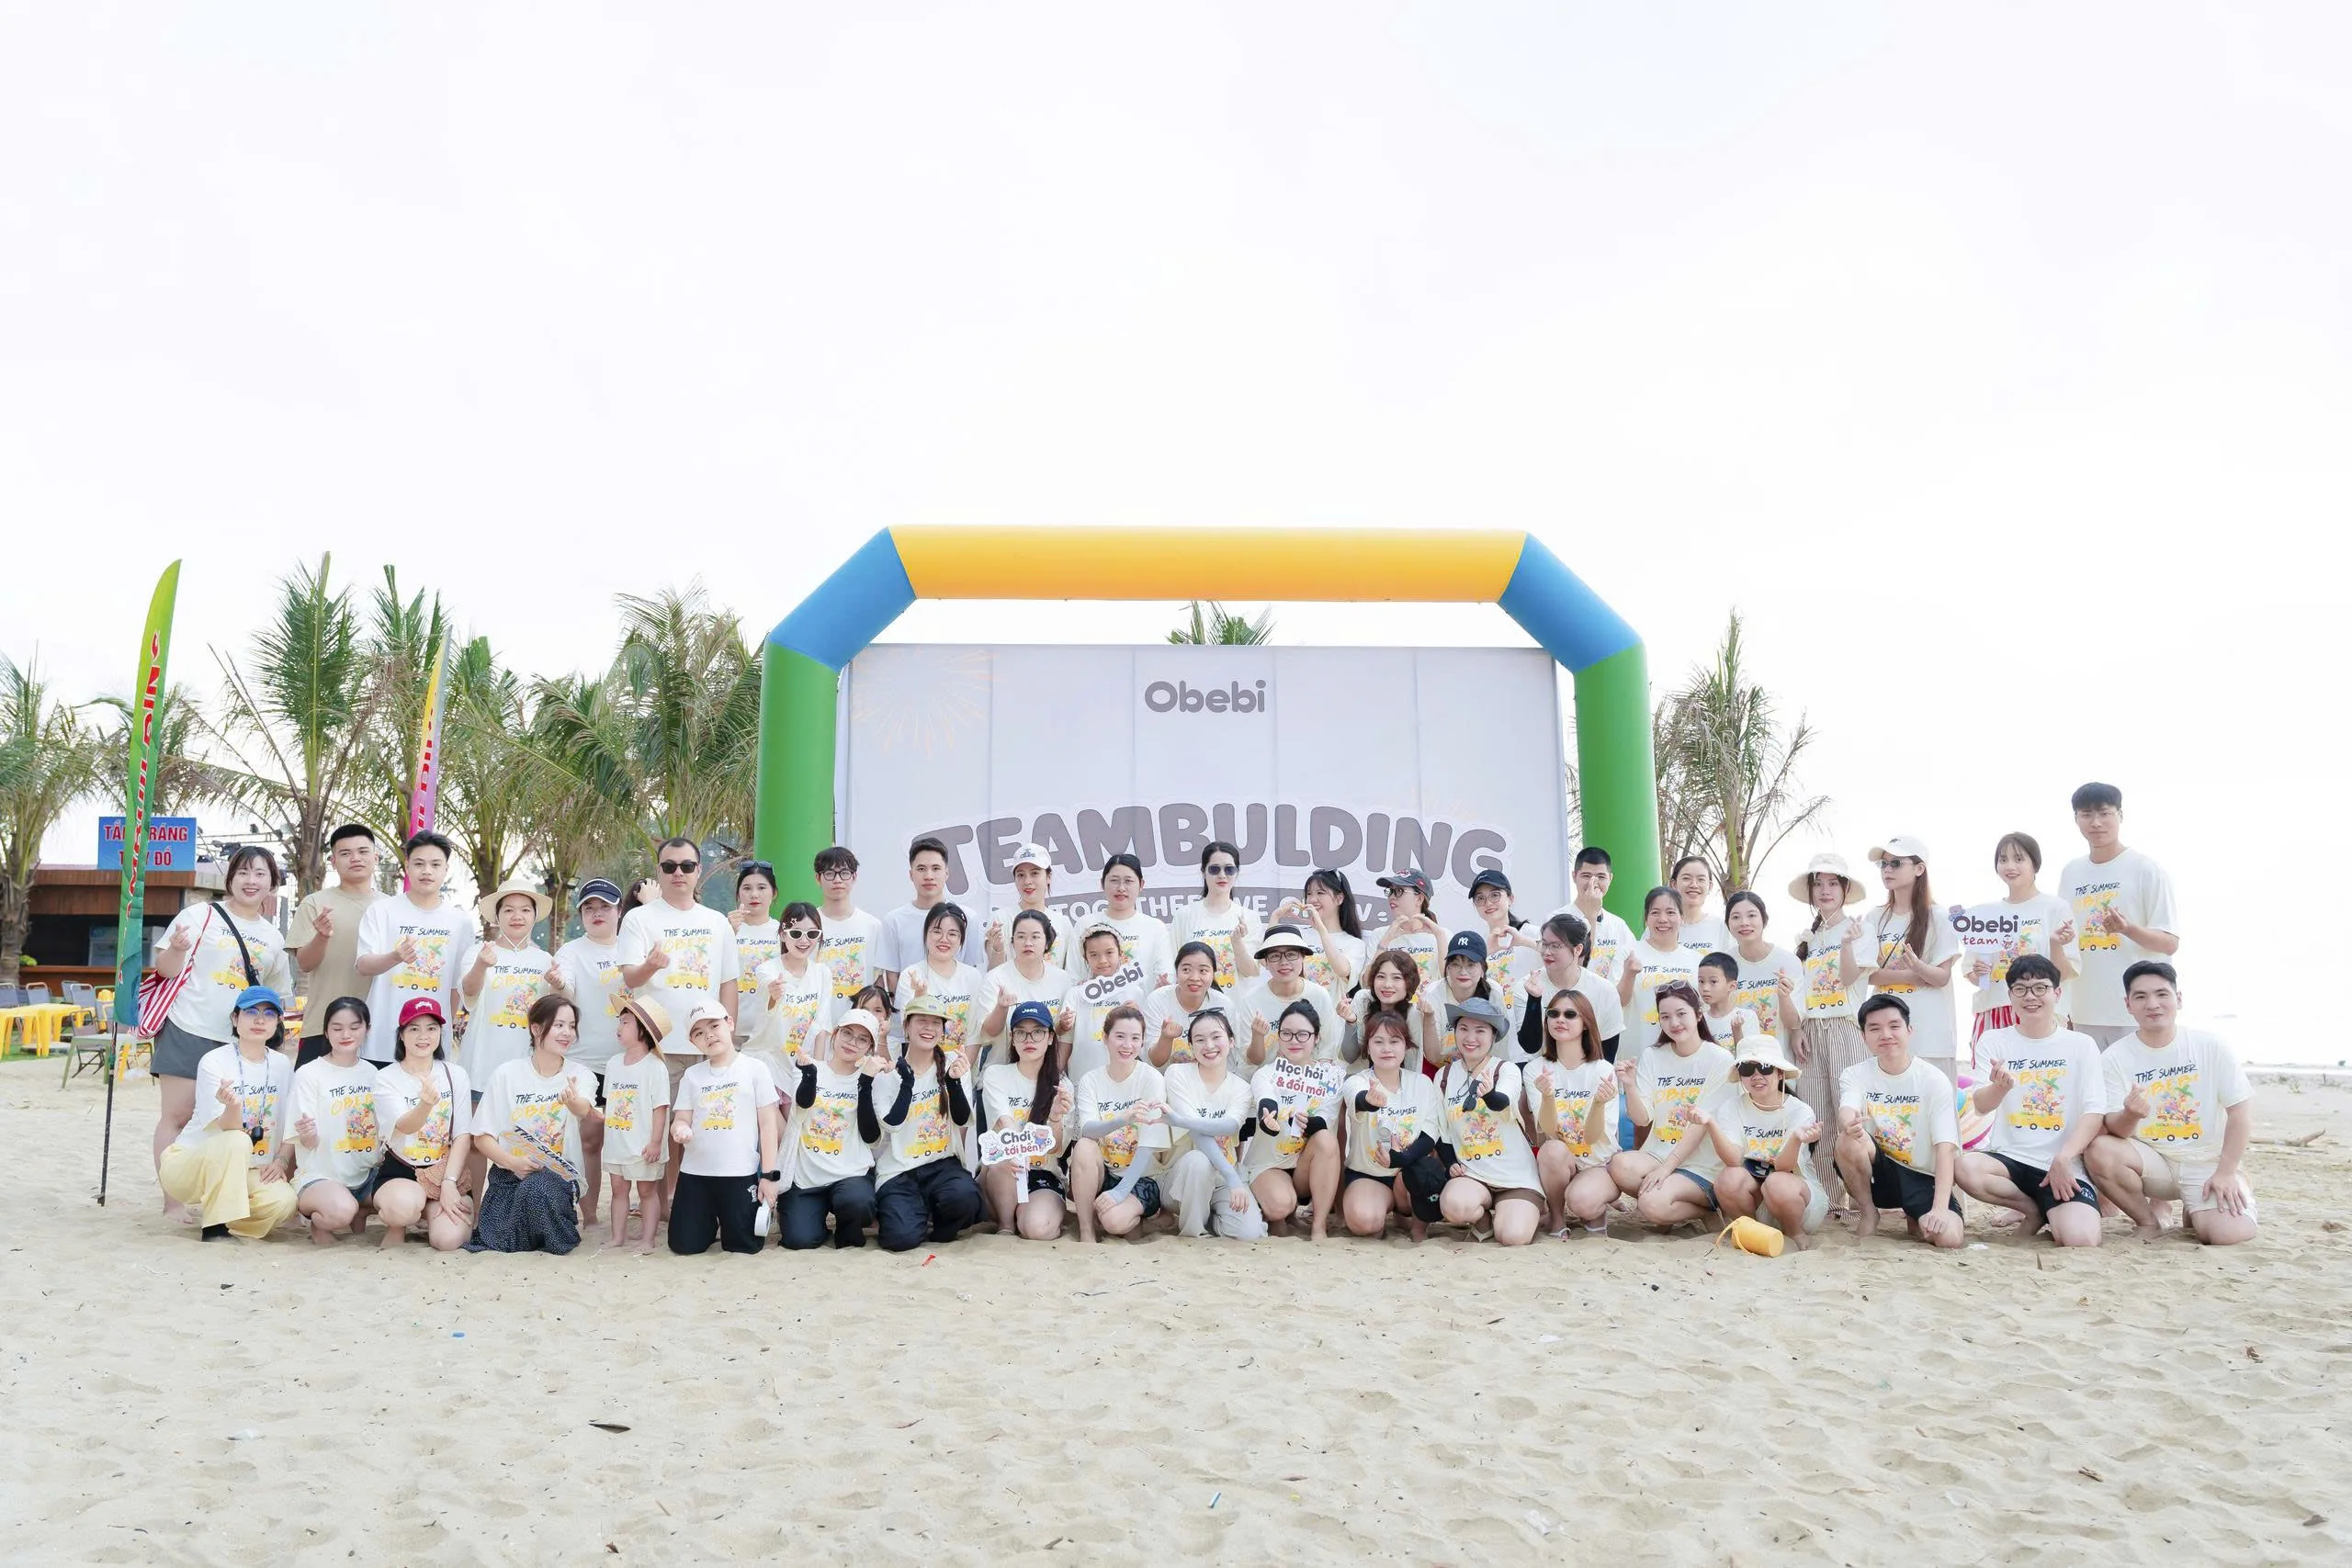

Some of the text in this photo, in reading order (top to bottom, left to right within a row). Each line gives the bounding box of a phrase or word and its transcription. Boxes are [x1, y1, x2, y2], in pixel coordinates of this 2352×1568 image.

[1145, 680, 1266, 713] Obebi
[149, 823, 187, 841] RÁNG
[912, 802, 1507, 895] TEAMBULDING
[2075, 882, 2121, 897] THE SUMMER
[1953, 915, 2018, 932] Obebi
[399, 926, 451, 937] THE SUMMER
[663, 928, 713, 937] THE SUMMER
[1193, 930, 1208, 938] THE
[835, 936, 865, 945] SUMMER
[1962, 933, 1998, 945] team
[494, 965, 543, 975] THE SUMMER
[1643, 965, 1658, 974] THE
[1084, 962, 1144, 1000] Obebi
[1747, 978, 1779, 988] SUMMER
[797, 993, 820, 1004] SUMME
[943, 995, 971, 1004] SUMMER
[1275, 1059, 1324, 1080] Học hỏi
[2007, 1059, 2067, 1070] THE SUMMER
[2135, 1064, 2198, 1084] THE SUMMER
[1275, 1077, 1327, 1098] & đổi mới
[1657, 1077, 1706, 1087] THE SUMMER
[330, 1087, 346, 1097] THE
[701, 1082, 739, 1094] THE SUMMER
[515, 1093, 559, 1104] THE SUMM
[823, 1090, 858, 1100] SUMMER
[1281, 1095, 1296, 1104] THE
[1866, 1092, 1919, 1104] THE SUMMER
[1001, 1130, 1031, 1145] Chơi
[1756, 1129, 1787, 1138] SUMME
[1004, 1144, 1020, 1156] tới
